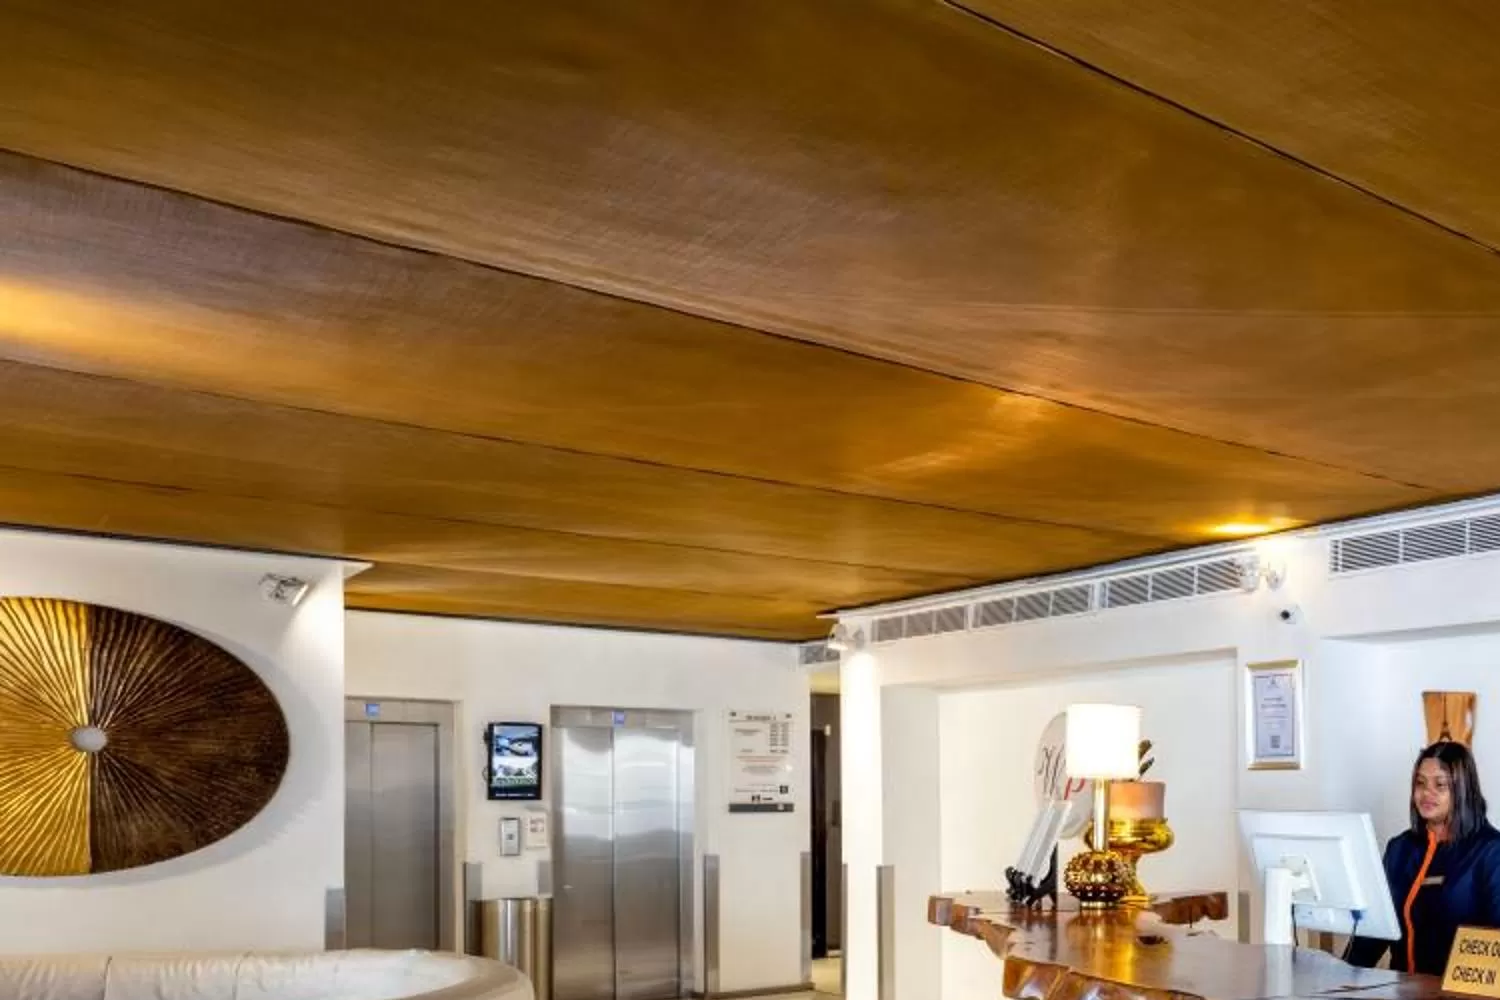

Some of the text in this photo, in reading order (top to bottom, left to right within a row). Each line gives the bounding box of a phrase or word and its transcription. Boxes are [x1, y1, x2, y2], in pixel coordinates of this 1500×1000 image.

[1459, 937, 1490, 957] CHECK
[1452, 965, 1485, 985] CHECK
[1483, 970, 1497, 985] IN
